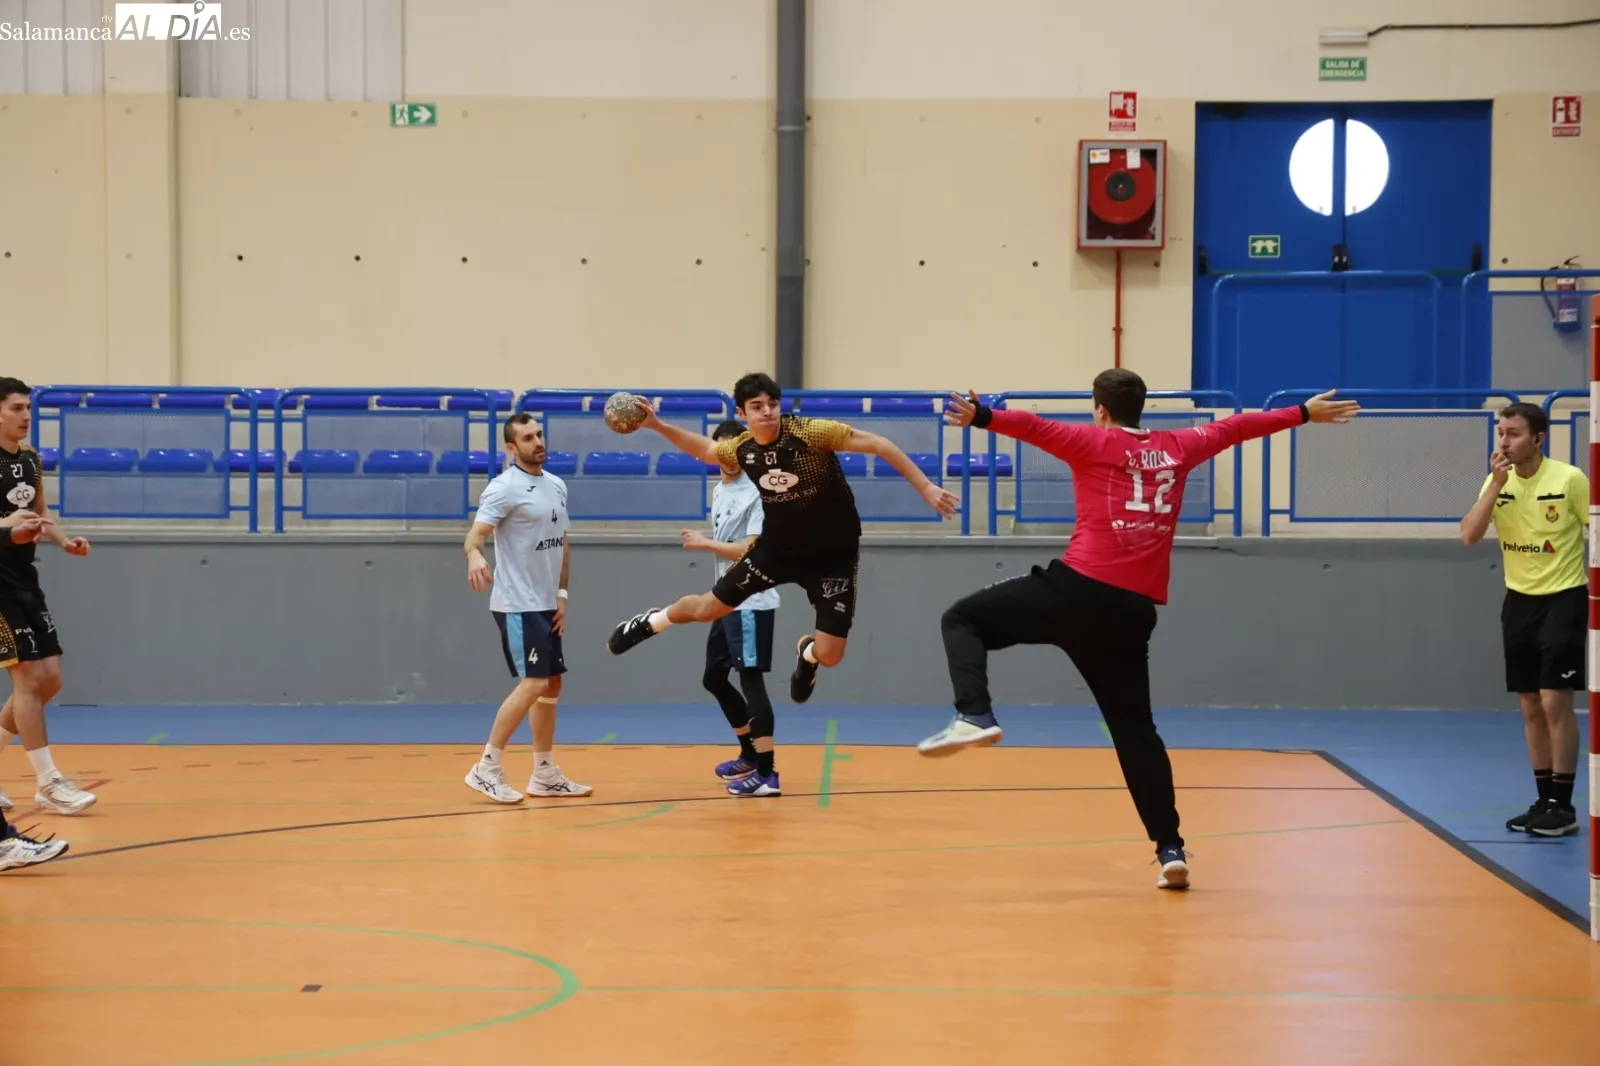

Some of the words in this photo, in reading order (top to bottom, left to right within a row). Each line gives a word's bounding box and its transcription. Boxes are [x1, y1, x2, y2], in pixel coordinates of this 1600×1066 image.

[10, 463, 23, 478] 27
[768, 475, 788, 486] CG
[16, 489, 30, 500] CG
[1125, 468, 1176, 513] 12
[551, 508, 558, 525] 4
[1503, 541, 1541, 554] helvetia
[528, 647, 538, 665] 4
